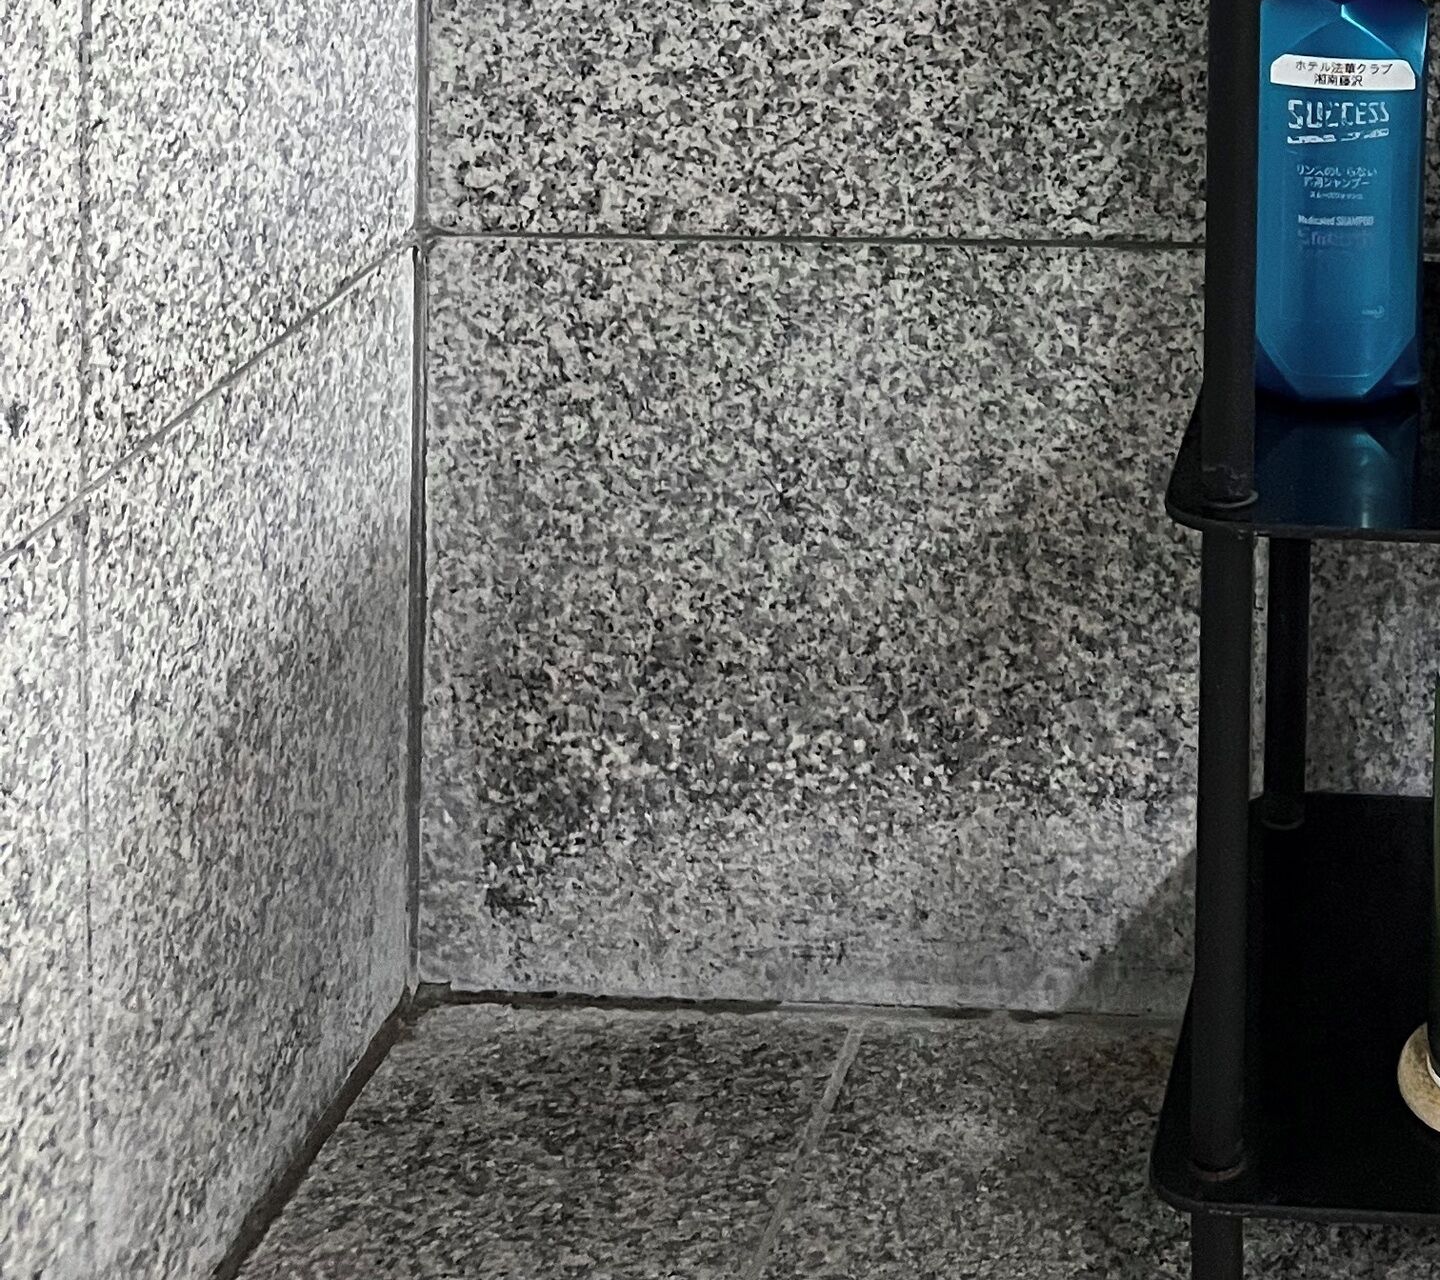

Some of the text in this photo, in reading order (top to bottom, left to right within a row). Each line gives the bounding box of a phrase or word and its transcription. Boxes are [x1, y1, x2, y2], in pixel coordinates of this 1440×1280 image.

[1295, 60, 1394, 75] ホテル法華クラブ
